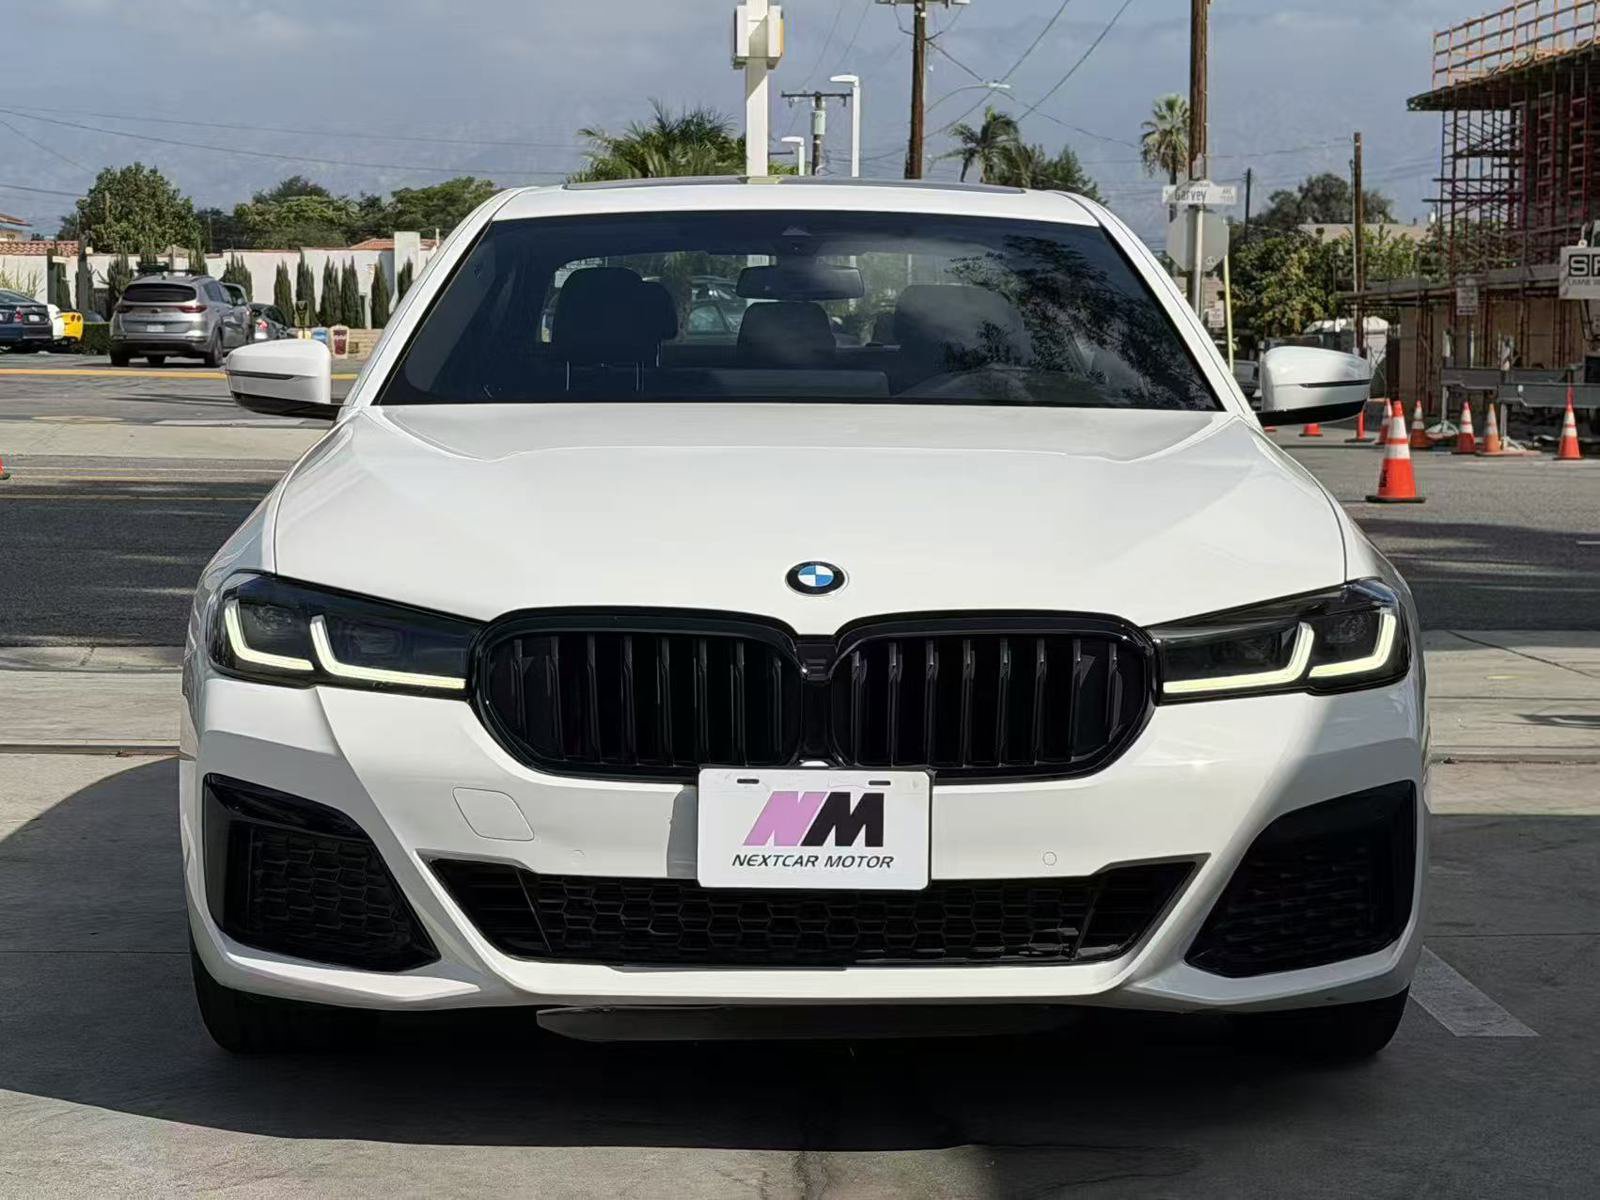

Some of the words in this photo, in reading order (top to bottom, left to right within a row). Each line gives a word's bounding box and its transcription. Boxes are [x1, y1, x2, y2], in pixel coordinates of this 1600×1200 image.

[1174, 185, 1207, 203] Garvey
[742, 790, 884, 847] NM
[732, 854, 819, 868] NEXTCAR
[824, 855, 894, 869] MOTOR
